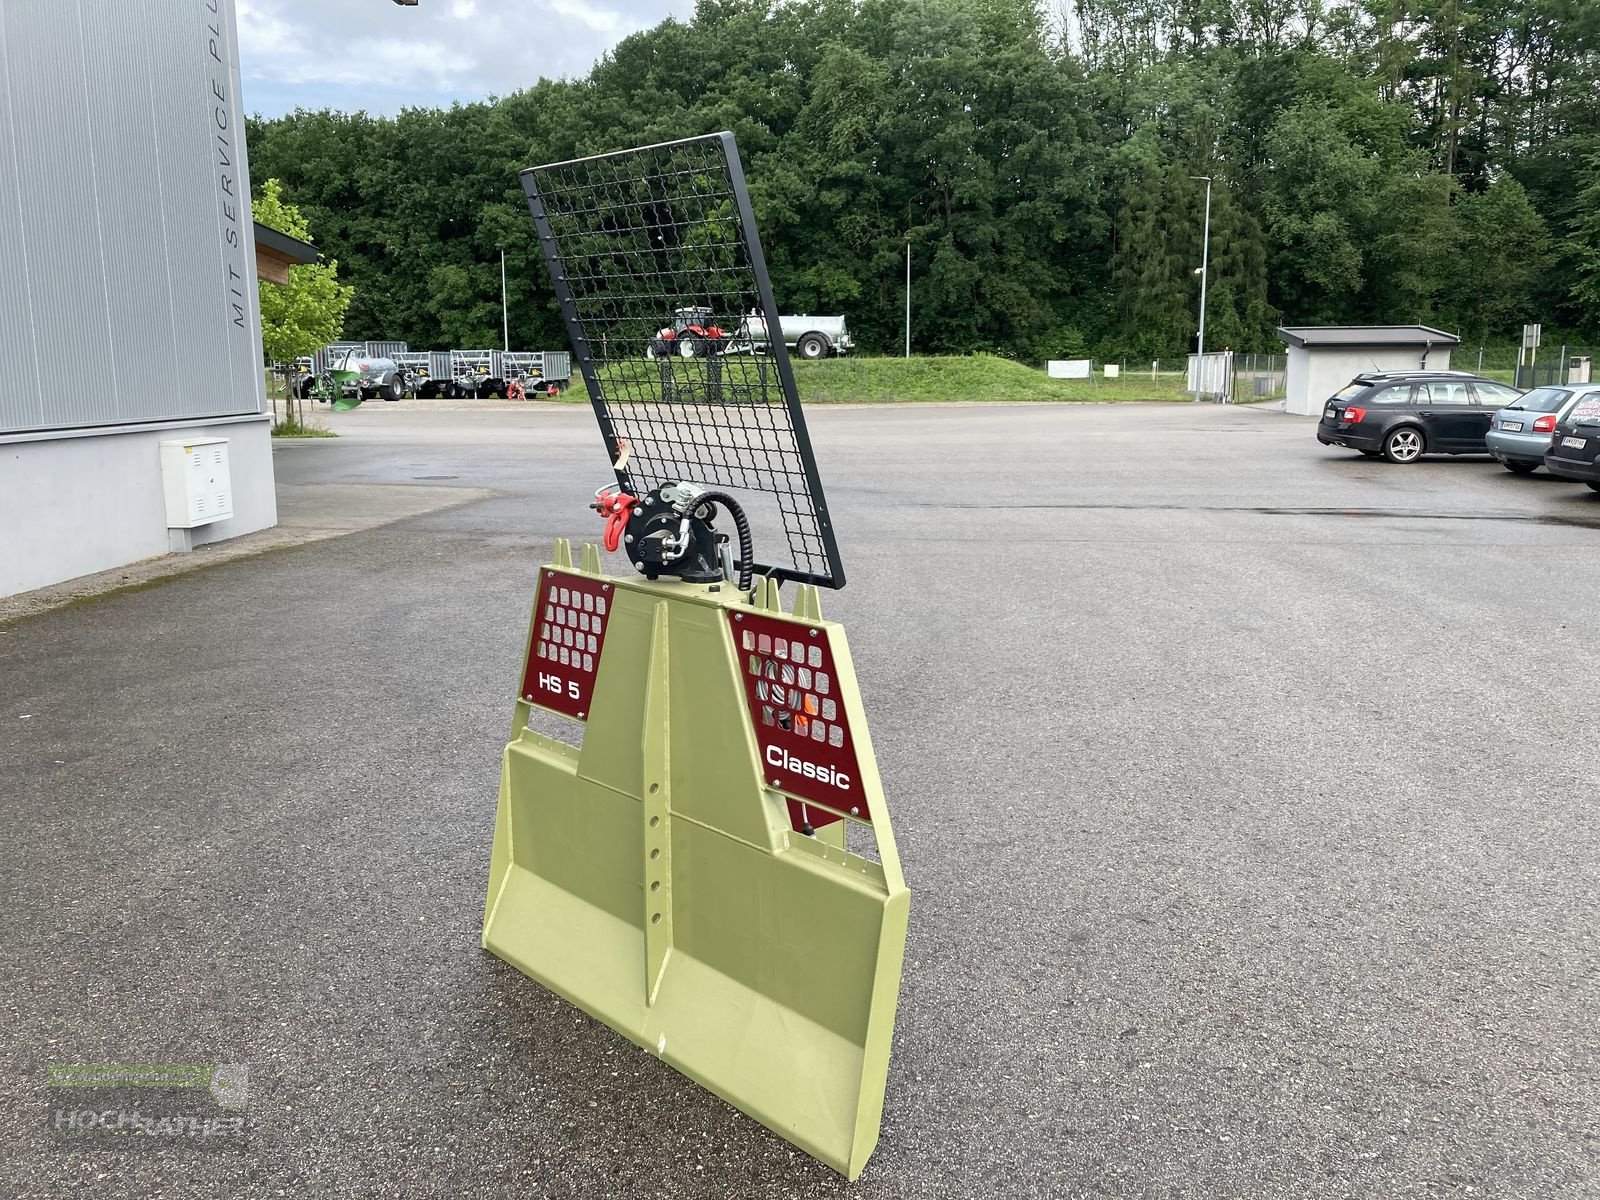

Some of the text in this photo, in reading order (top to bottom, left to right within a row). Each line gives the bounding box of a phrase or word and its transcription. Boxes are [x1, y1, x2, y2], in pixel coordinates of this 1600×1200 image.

[212, 79, 238, 248] SERVICE
[229, 264, 245, 328] MIT
[539, 671, 580, 700] HS 5
[766, 744, 850, 790] Classic
